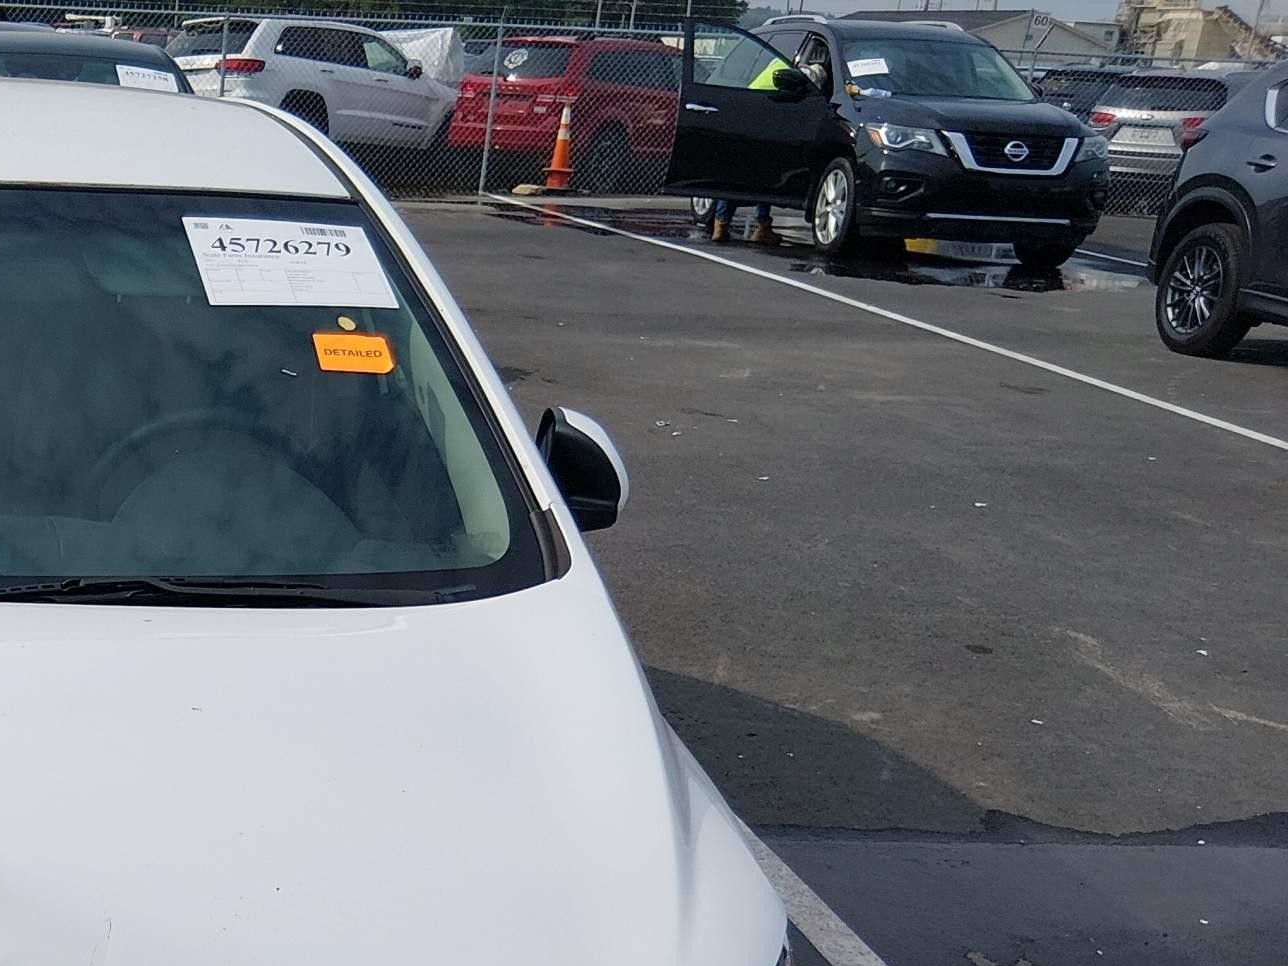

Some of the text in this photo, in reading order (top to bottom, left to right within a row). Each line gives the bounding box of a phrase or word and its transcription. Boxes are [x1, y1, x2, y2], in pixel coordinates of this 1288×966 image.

[1034, 15, 1049, 26] 60
[210, 237, 352, 257] 45726279
[323, 348, 383, 358] DETAILED
